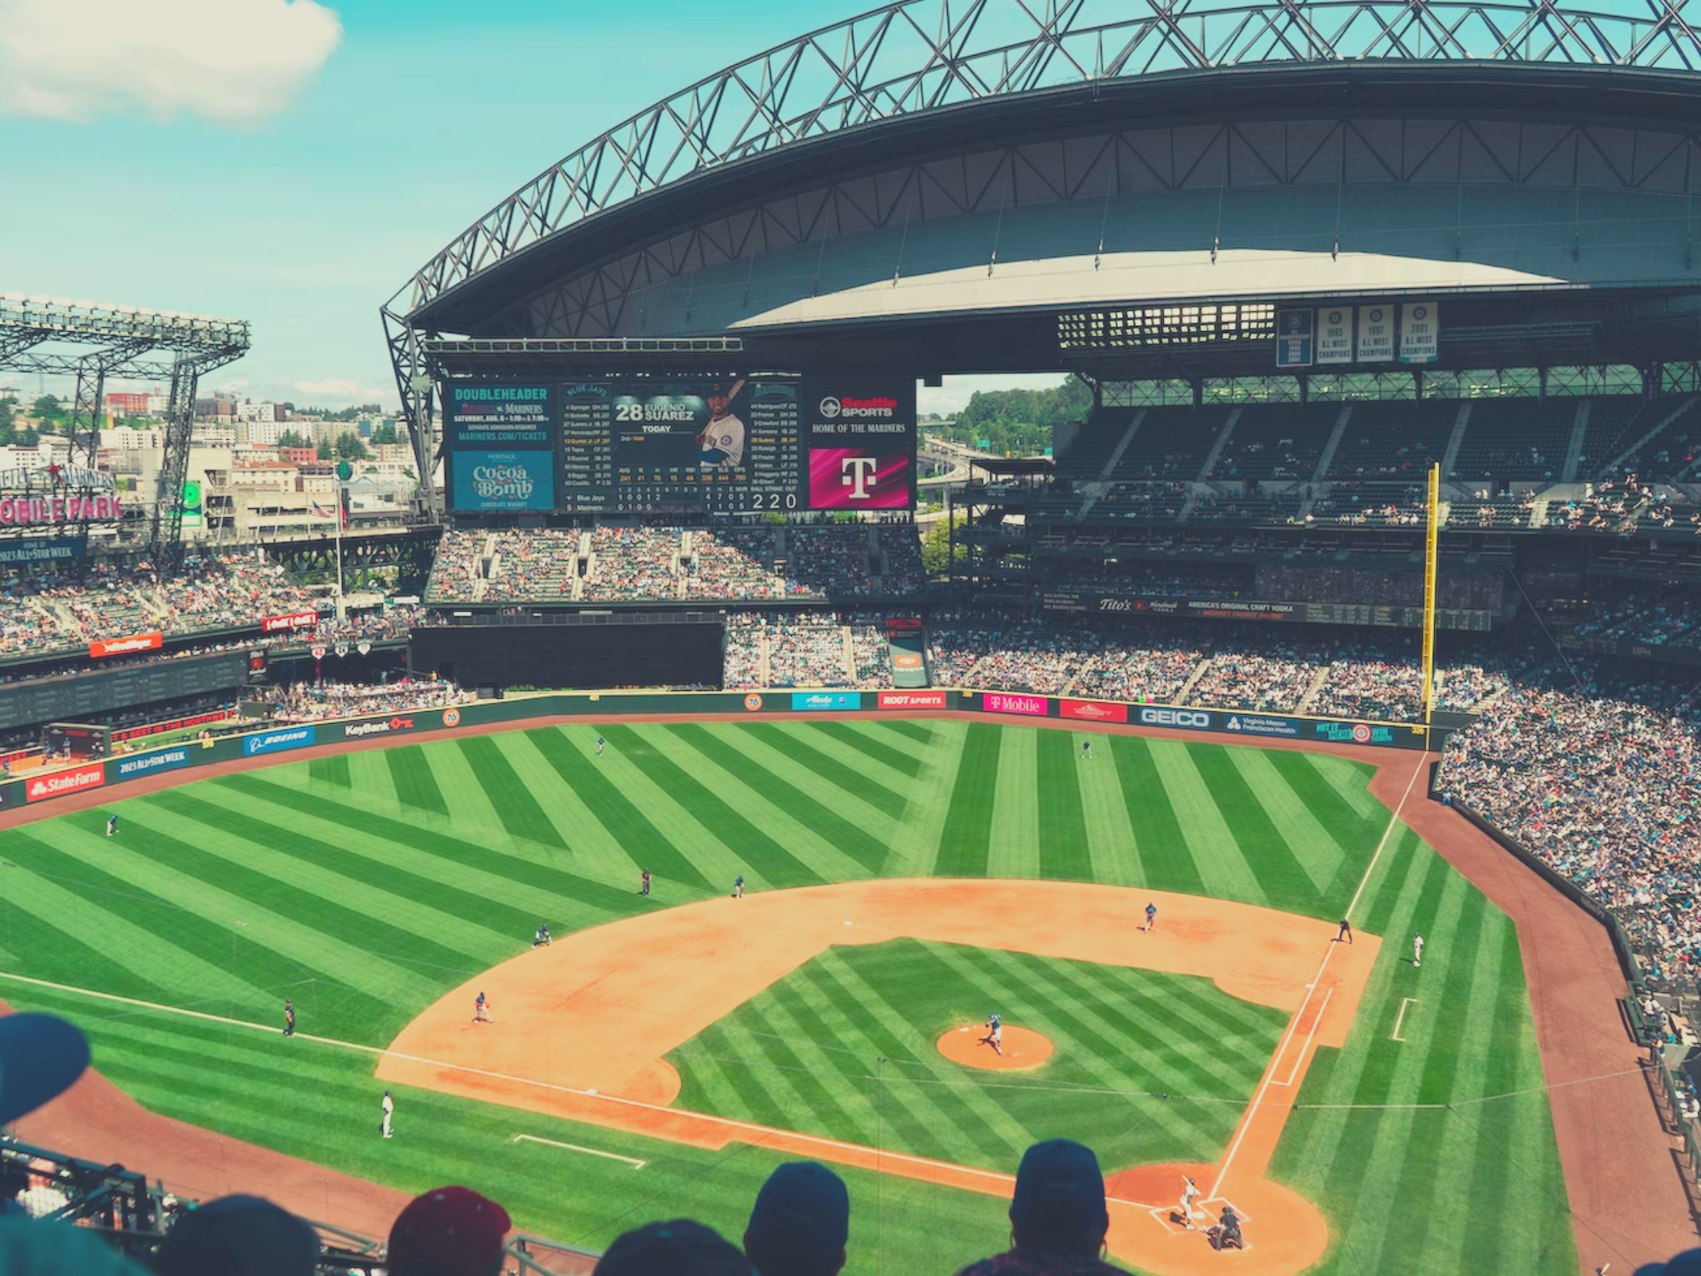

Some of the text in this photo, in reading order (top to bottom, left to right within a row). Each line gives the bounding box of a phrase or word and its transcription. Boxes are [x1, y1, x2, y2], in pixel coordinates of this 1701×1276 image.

[1411, 324, 1428, 334] 2001
[455, 388, 547, 400] DOUBLEHEADER
[566, 384, 608, 398] BLUE JAYS
[505, 403, 543, 414] MARINERS
[841, 397, 897, 408] Seattle
[615, 404, 644, 421] 28
[842, 407, 893, 417] SPORTS
[641, 425, 672, 433] TODAY
[812, 423, 905, 433] HOME OF THE MARINERS
[458, 431, 547, 440] MARINERS.COM/TICKETS
[473, 466, 529, 482] Cocoa
[842, 457, 877, 499] T
[478, 480, 533, 500] Bomb
[753, 493, 797, 509] 2 2 0
[68, 496, 121, 519] PARK
[50, 546, 72, 558] WEEK
[1100, 598, 1132, 611] Tito's
[1188, 601, 1220, 609] AMERICA'S
[1271, 604, 1293, 612] VODKA
[1632, 646, 1651, 656] MPH
[883, 696, 941, 705] ROOT SPORTS
[1002, 698, 1040, 713] Mobile
[447, 713, 457, 721] 76
[1141, 709, 1210, 727] GEICO
[1266, 719, 1287, 727] Mason
[345, 721, 390, 737] KeyBank
[1373, 727, 1388, 736] WIN
[264, 731, 308, 745] BOEING
[120, 761, 137, 774] 2023
[164, 751, 185, 763] WEEK
